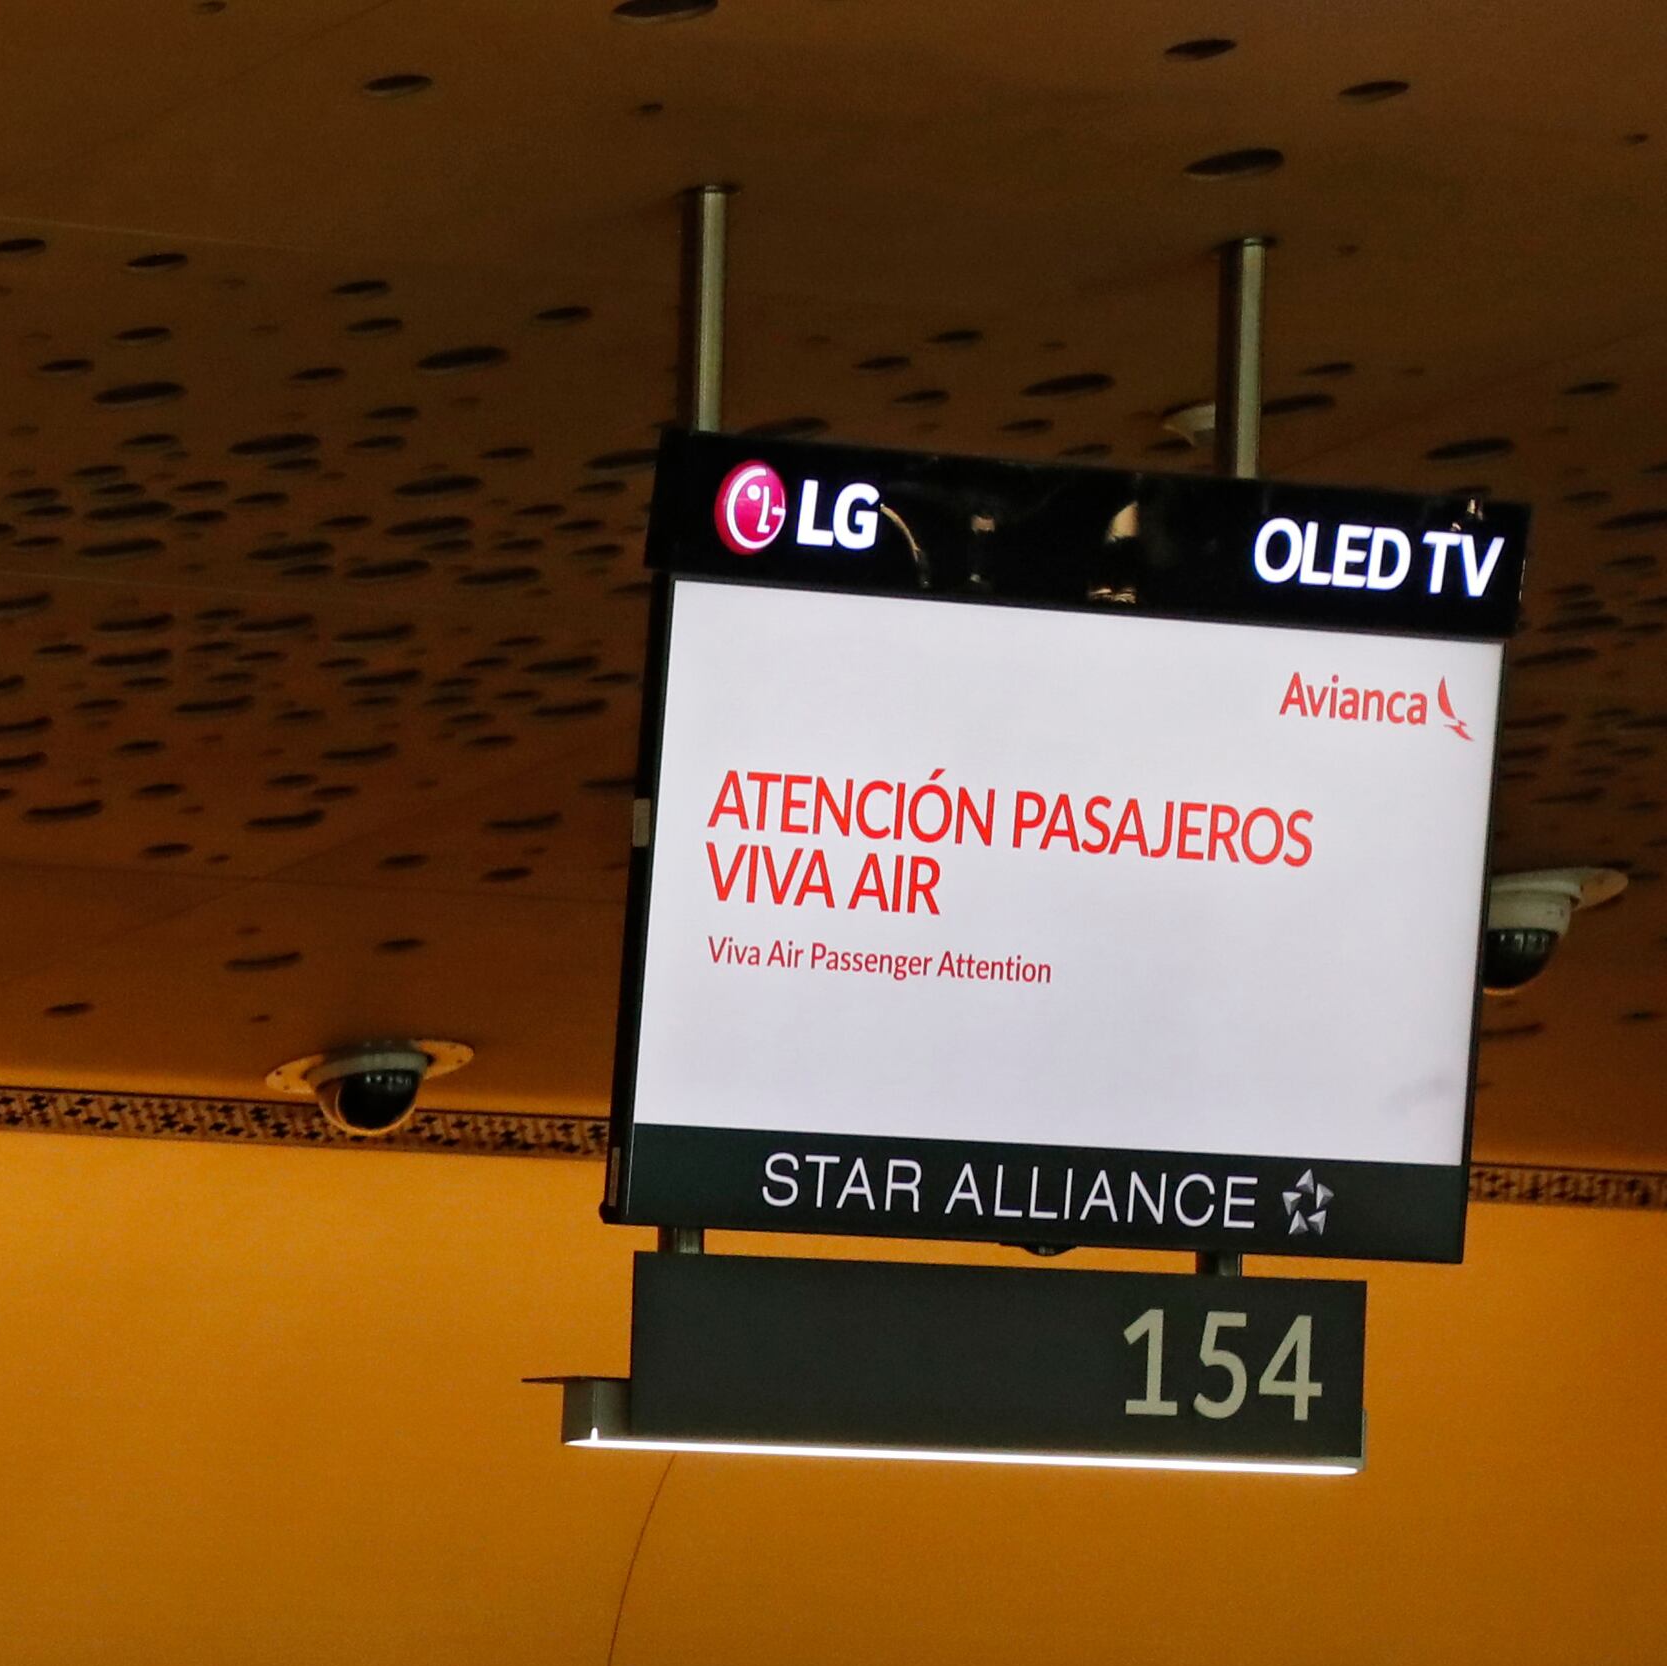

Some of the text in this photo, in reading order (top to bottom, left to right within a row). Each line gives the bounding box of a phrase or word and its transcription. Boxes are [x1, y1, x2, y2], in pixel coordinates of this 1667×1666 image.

[797, 479, 879, 549] LG
[1254, 517, 1504, 597] OLED TV
[1280, 672, 1428, 726] Avianca
[707, 768, 1313, 868] ATENCIÓN PASAJEROS
[706, 843, 940, 915] VIVA AIR
[708, 937, 1051, 983] Viva Air Passenger Attention
[762, 1154, 1257, 1227] STAR ALLIANCE
[1124, 1309, 1322, 1421] 154
